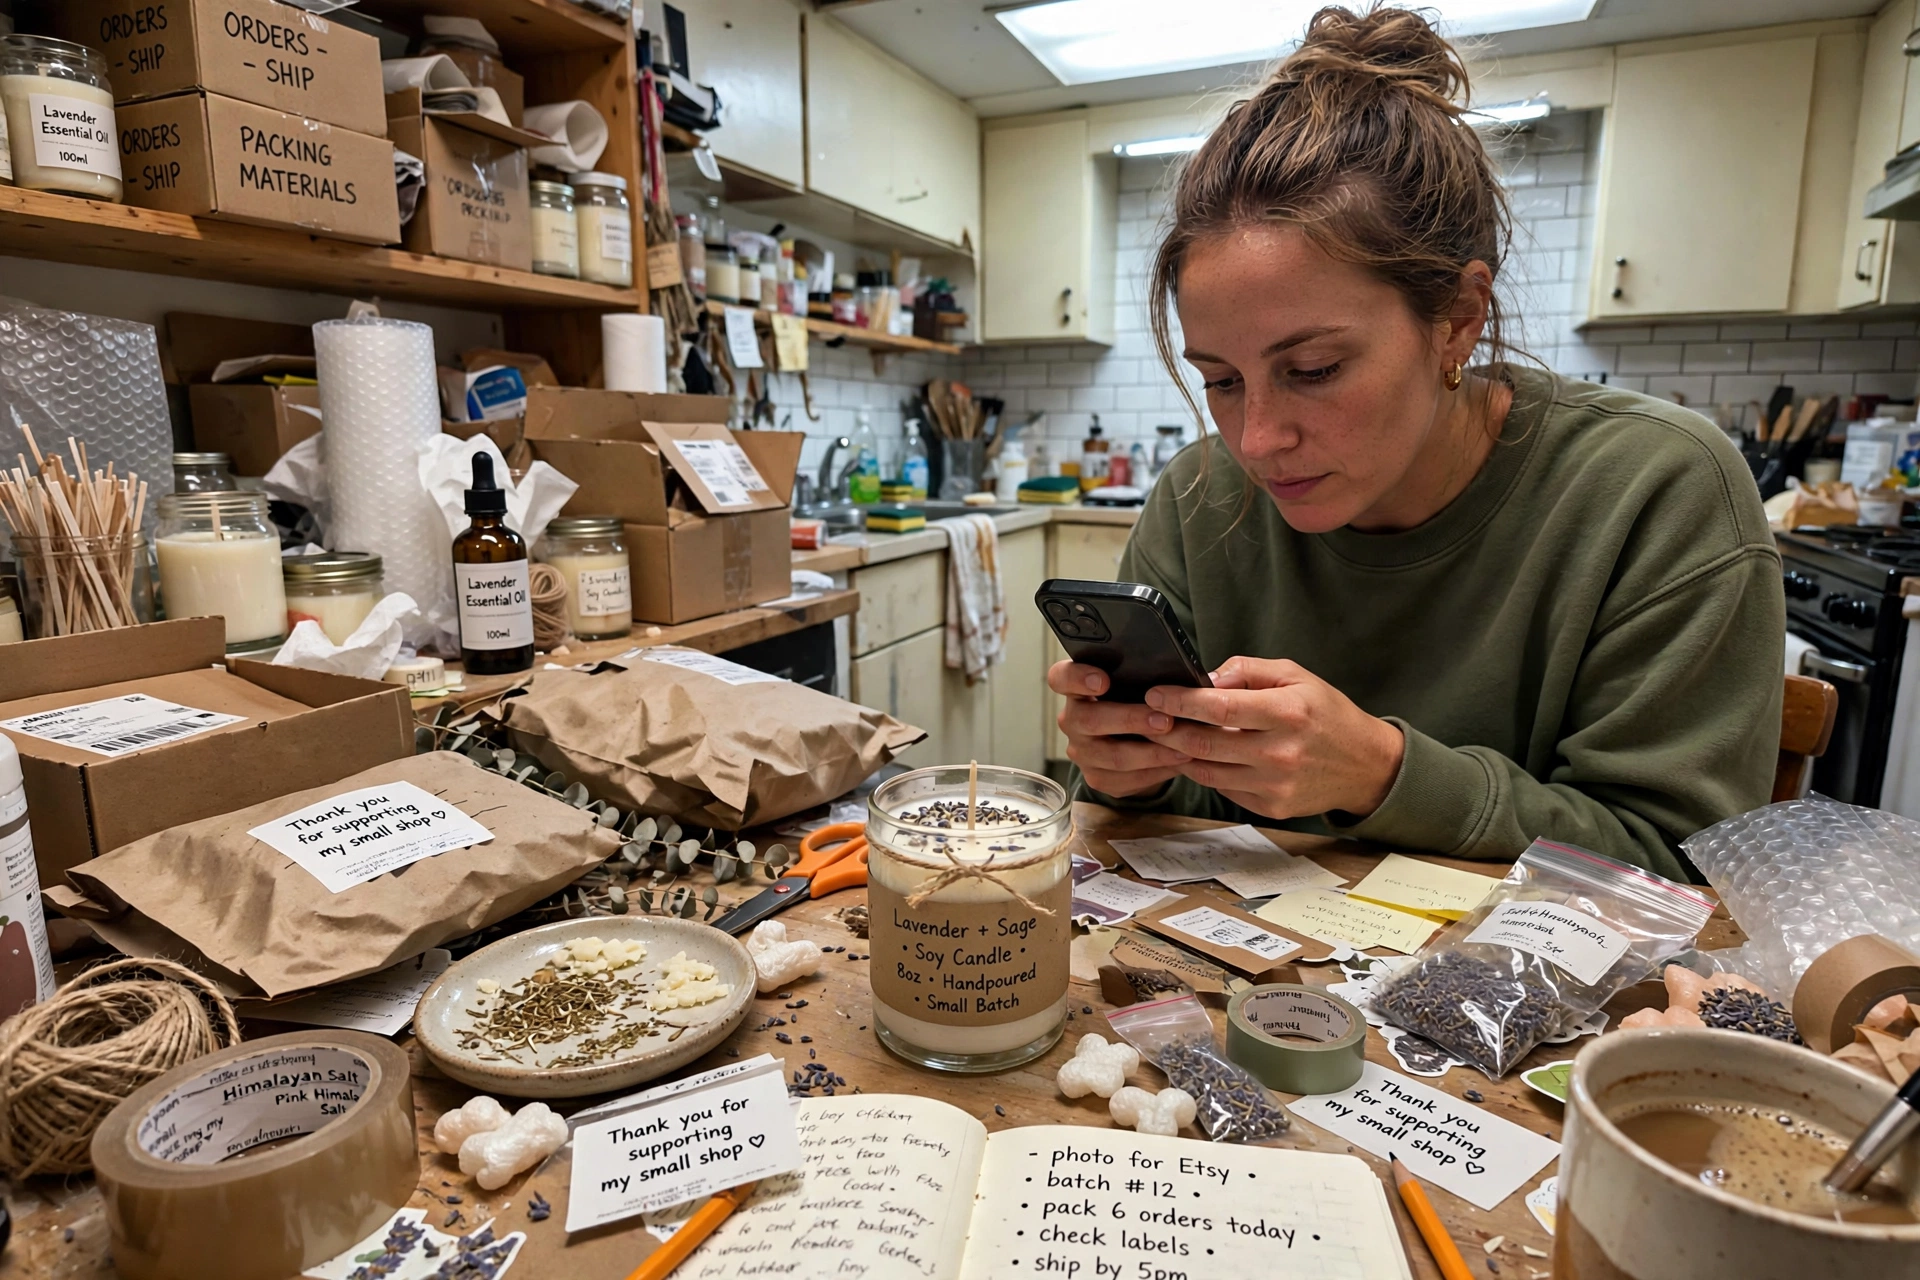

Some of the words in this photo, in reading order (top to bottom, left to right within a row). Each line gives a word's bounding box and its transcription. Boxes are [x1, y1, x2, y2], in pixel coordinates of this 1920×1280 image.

[100, 5, 168, 43] ORDERS
[224, 11, 310, 56] ORDERS
[128, 44, 165, 75] SHIP
[266, 58, 315, 91] SHIP
[43, 104, 97, 125] Lavender
[41, 121, 93, 140] Essential
[95, 130, 109, 144] Oil
[121, 123, 181, 156] ORDERS
[240, 125, 332, 167] PACKING
[59, 151, 89, 165] 100ml
[142, 161, 181, 191] SHIP
[240, 163, 357, 204] MATERIALS
[466, 592, 512, 607] Essential
[514, 589, 526, 604] Oil
[468, 576, 517, 590] Lavender
[486, 628, 511, 640] 100ml
[285, 804, 352, 831] Thank
[356, 794, 391, 812] you
[298, 831, 324, 846] for
[332, 803, 420, 834] supporting
[318, 843, 347, 858] my
[349, 824, 393, 847] small
[395, 815, 432, 832] shop
[893, 907, 970, 939] Lavender
[997, 915, 1037, 939] Sage
[915, 943, 945, 970] Soy
[953, 945, 1012, 967] Candle
[897, 962, 922, 984] 8oz
[943, 962, 1037, 995] Handpoured
[927, 994, 968, 1014] Small
[976, 992, 1020, 1013] Batch
[223, 1071, 322, 1101] Himalayan
[328, 1069, 360, 1085] Salt
[275, 1090, 311, 1105] Pink
[320, 1103, 347, 1116] Salt
[607, 1117, 670, 1145] Thank
[679, 1108, 713, 1131] you
[720, 1098, 750, 1115] for
[1380, 1079, 1438, 1114] Thank
[1440, 1112, 1481, 1134] you
[1325, 1099, 1354, 1118] my
[1356, 1114, 1409, 1141] small
[1410, 1137, 1457, 1166] shop
[1353, 1089, 1382, 1107] for
[1385, 1105, 1487, 1160] supporting
[628, 1125, 733, 1162] supporting
[601, 1175, 631, 1193] my
[639, 1153, 691, 1182] small
[699, 1143, 744, 1166] shop
[1047, 1170, 1111, 1192] batch
[1051, 1145, 1115, 1168] photo
[1128, 1150, 1164, 1171] for
[1179, 1157, 1231, 1186] Etsy
[1039, 1223, 1107, 1247] check
[1121, 1229, 1190, 1257] labels
[1042, 1198, 1097, 1220] pack
[1111, 1201, 1126, 1219] 6
[1139, 1207, 1213, 1231] orders
[1226, 1216, 1296, 1249] today
[1034, 1252, 1081, 1280] ship
[1095, 1256, 1123, 1280] by
[1137, 1261, 1188, 1280] 5pm
